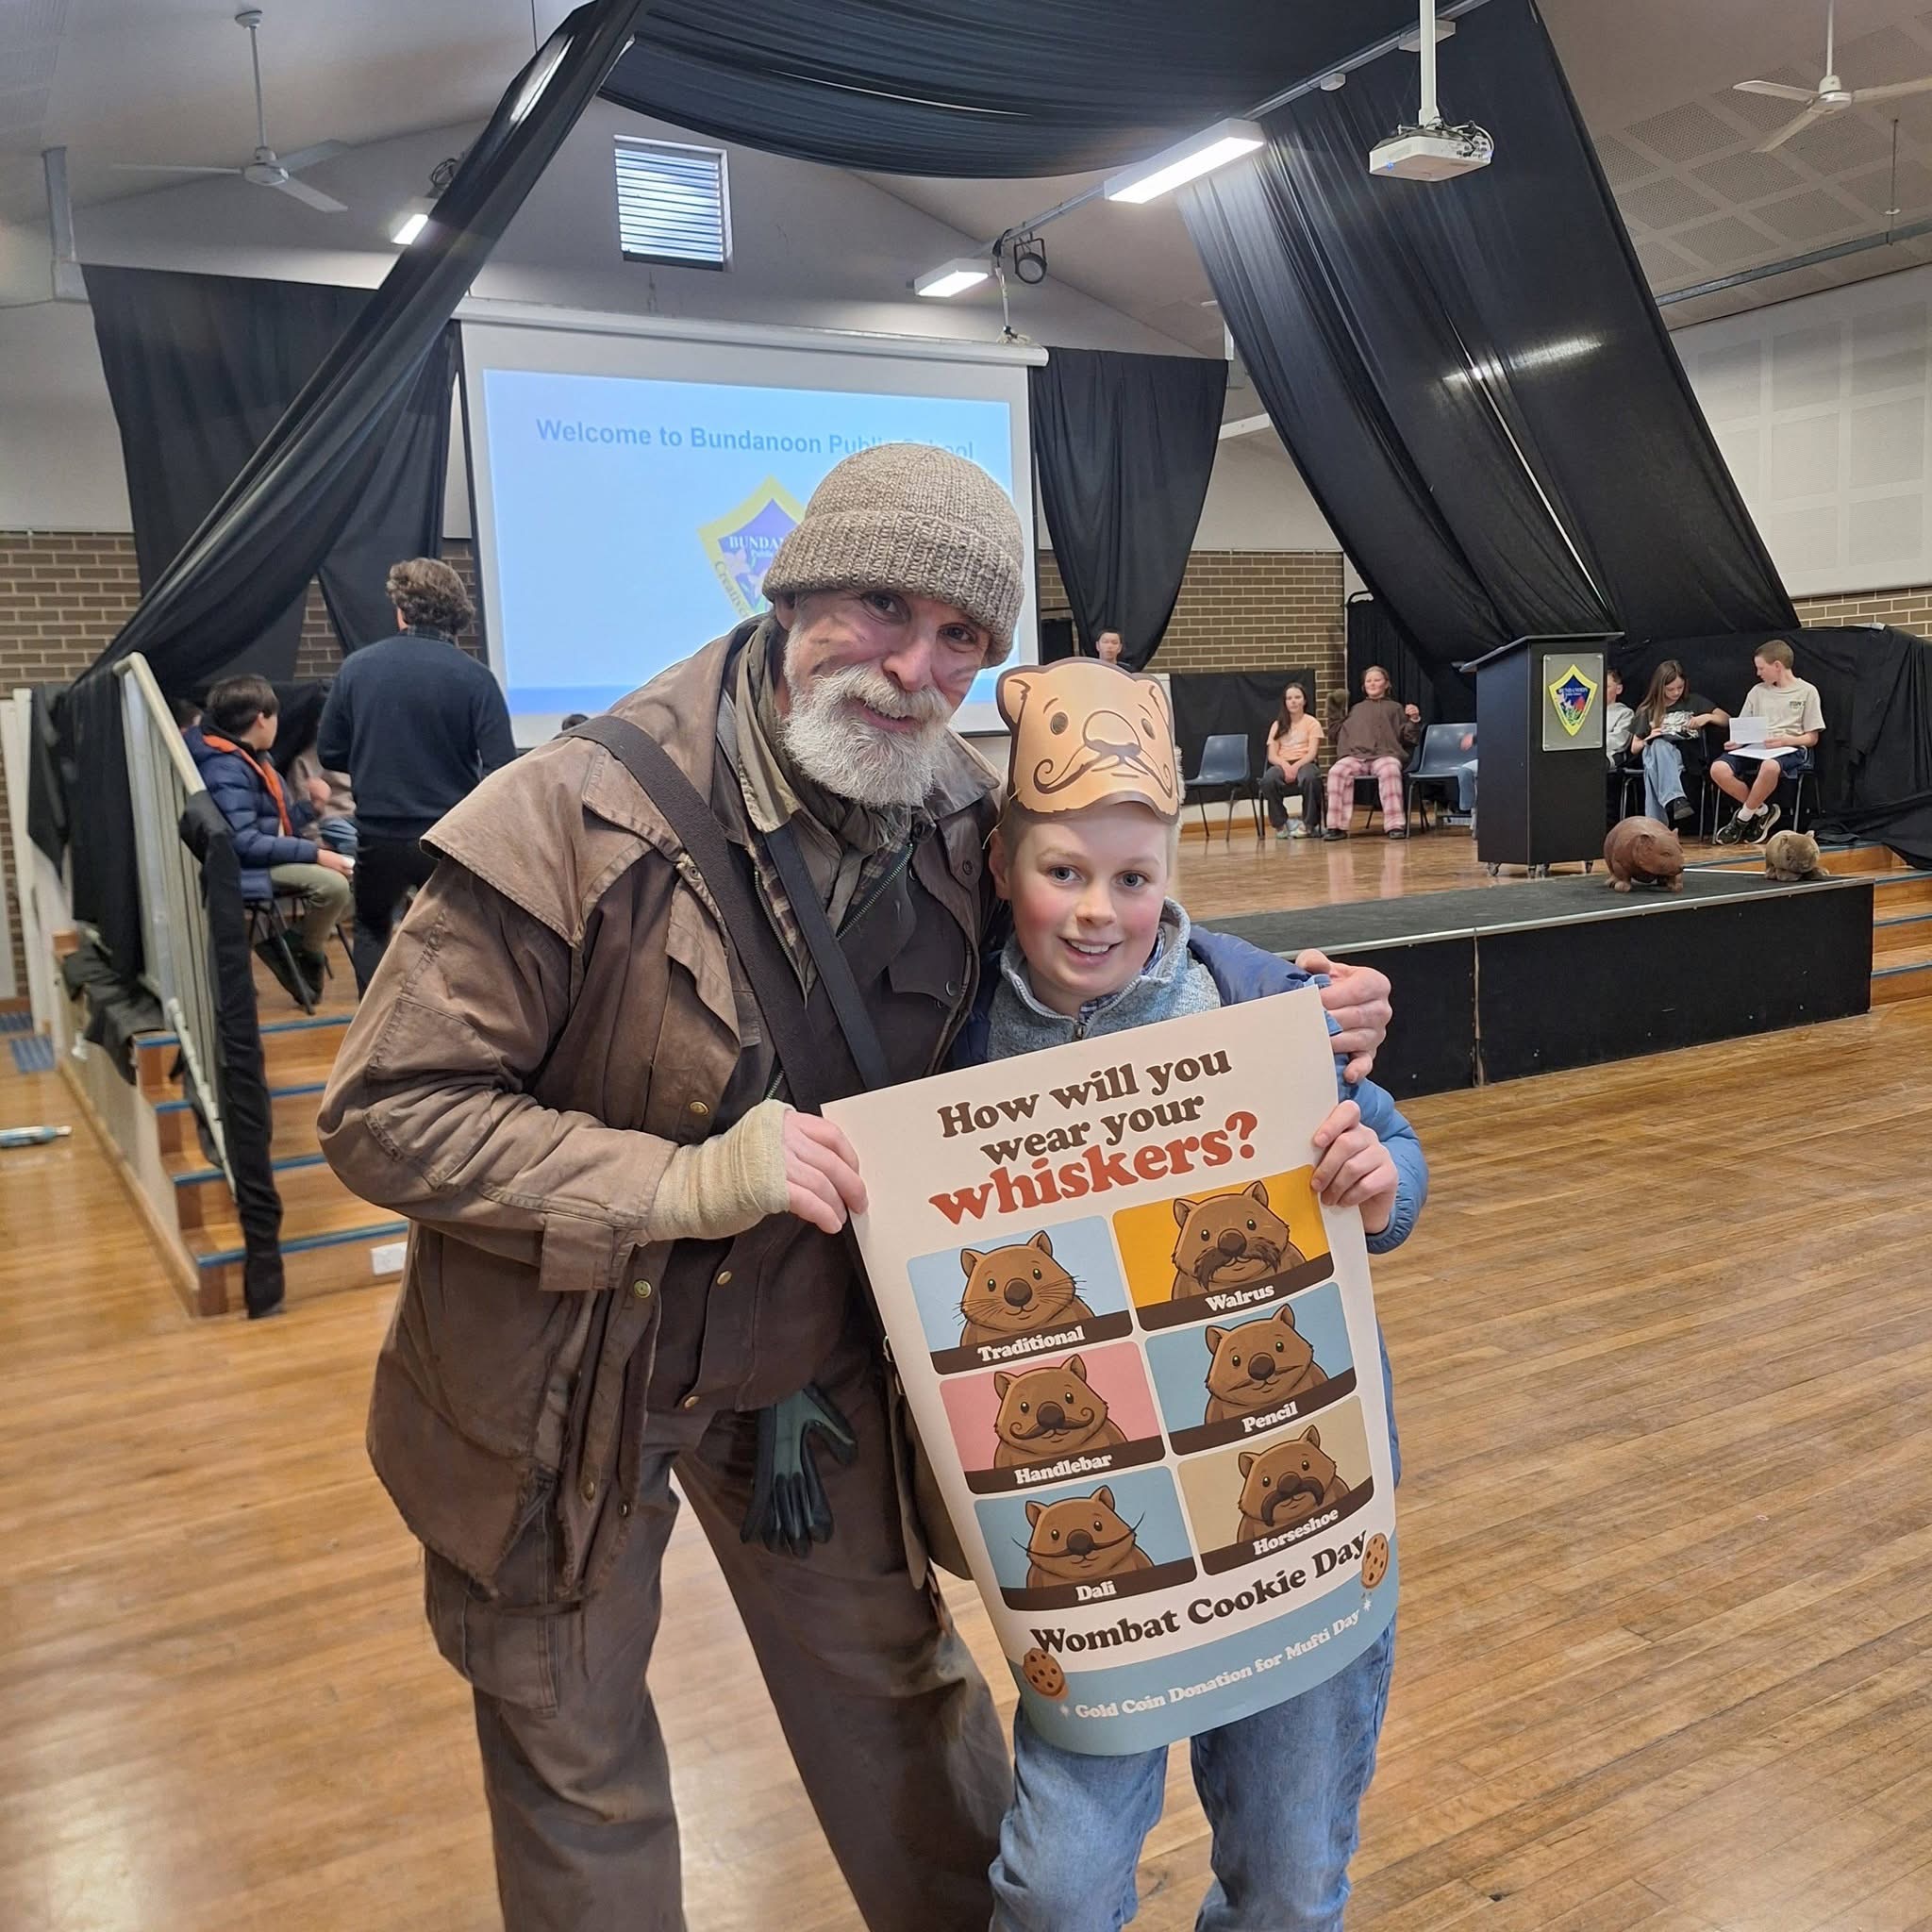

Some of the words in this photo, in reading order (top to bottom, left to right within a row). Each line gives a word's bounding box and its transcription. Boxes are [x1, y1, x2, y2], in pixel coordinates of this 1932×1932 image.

[536, 418, 651, 445] Welcome
[660, 426, 682, 446] to
[691, 427, 821, 454] Bundanoon
[729, 536, 785, 549] BUNDA
[938, 1094, 1039, 1138] How
[1049, 1062, 1140, 1109] will
[1146, 1049, 1231, 1096] you
[980, 1122, 1091, 1165] wear
[1100, 1095, 1204, 1146] your
[928, 1111, 1257, 1224] whiskers?
[1205, 1283, 1275, 1311] Walrus
[977, 1325, 1086, 1362] Traditional
[1242, 1402, 1299, 1432] Pencil
[1014, 1452, 1112, 1485] Handlebar
[1253, 1507, 1340, 1556] Horseshoe
[1030, 1610, 1180, 1655] Wombat
[1188, 1570, 1307, 1624] Cookie
[1312, 1530, 1367, 1576] Day
[1075, 1702, 1117, 1719] Gold
[1122, 1695, 1165, 1714] Coin
[1168, 1666, 1253, 1703] Donation
[1255, 1651, 1283, 1674] for
[1285, 1627, 1331, 1661] Mufti
[1333, 1609, 1360, 1637] Day
